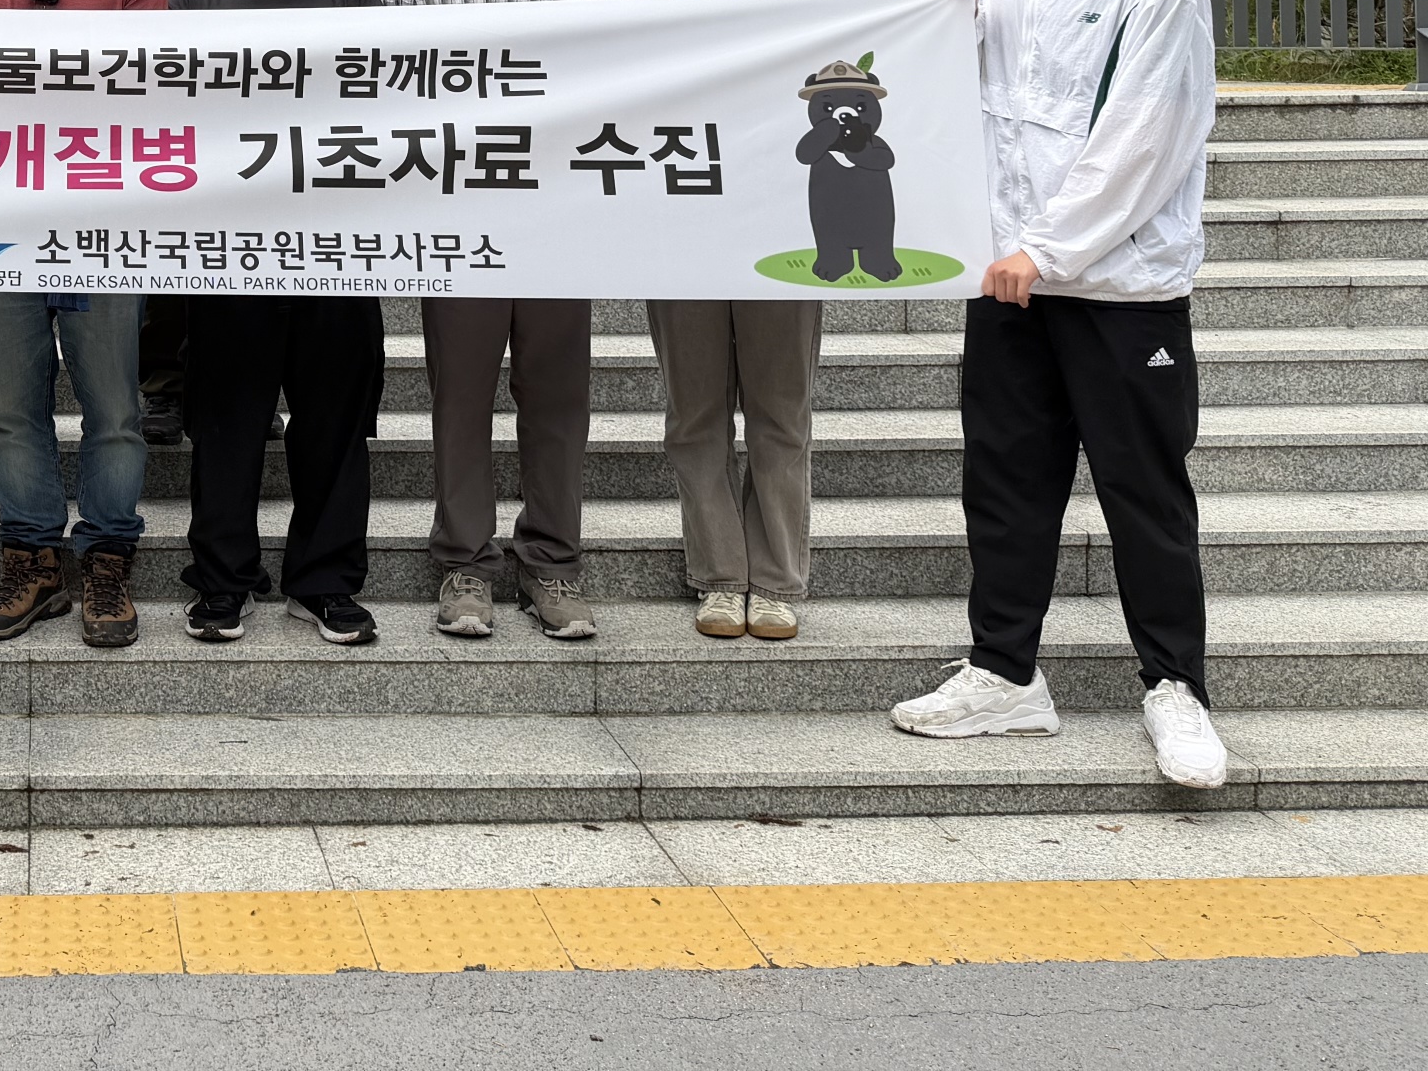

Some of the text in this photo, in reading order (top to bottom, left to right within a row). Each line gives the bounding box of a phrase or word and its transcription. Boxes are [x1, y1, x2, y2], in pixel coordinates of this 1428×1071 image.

[334, 47, 548, 100] 함께하는
[237, 122, 539, 195] 기초자료
[569, 122, 724, 196] 수집
[34, 228, 507, 273] 소백산국립공원북부사무소
[37, 274, 454, 293] SOBAEKSAN NATIONAL PARK NORTHERN OFFICE
[1146, 358, 1175, 367] adidas
